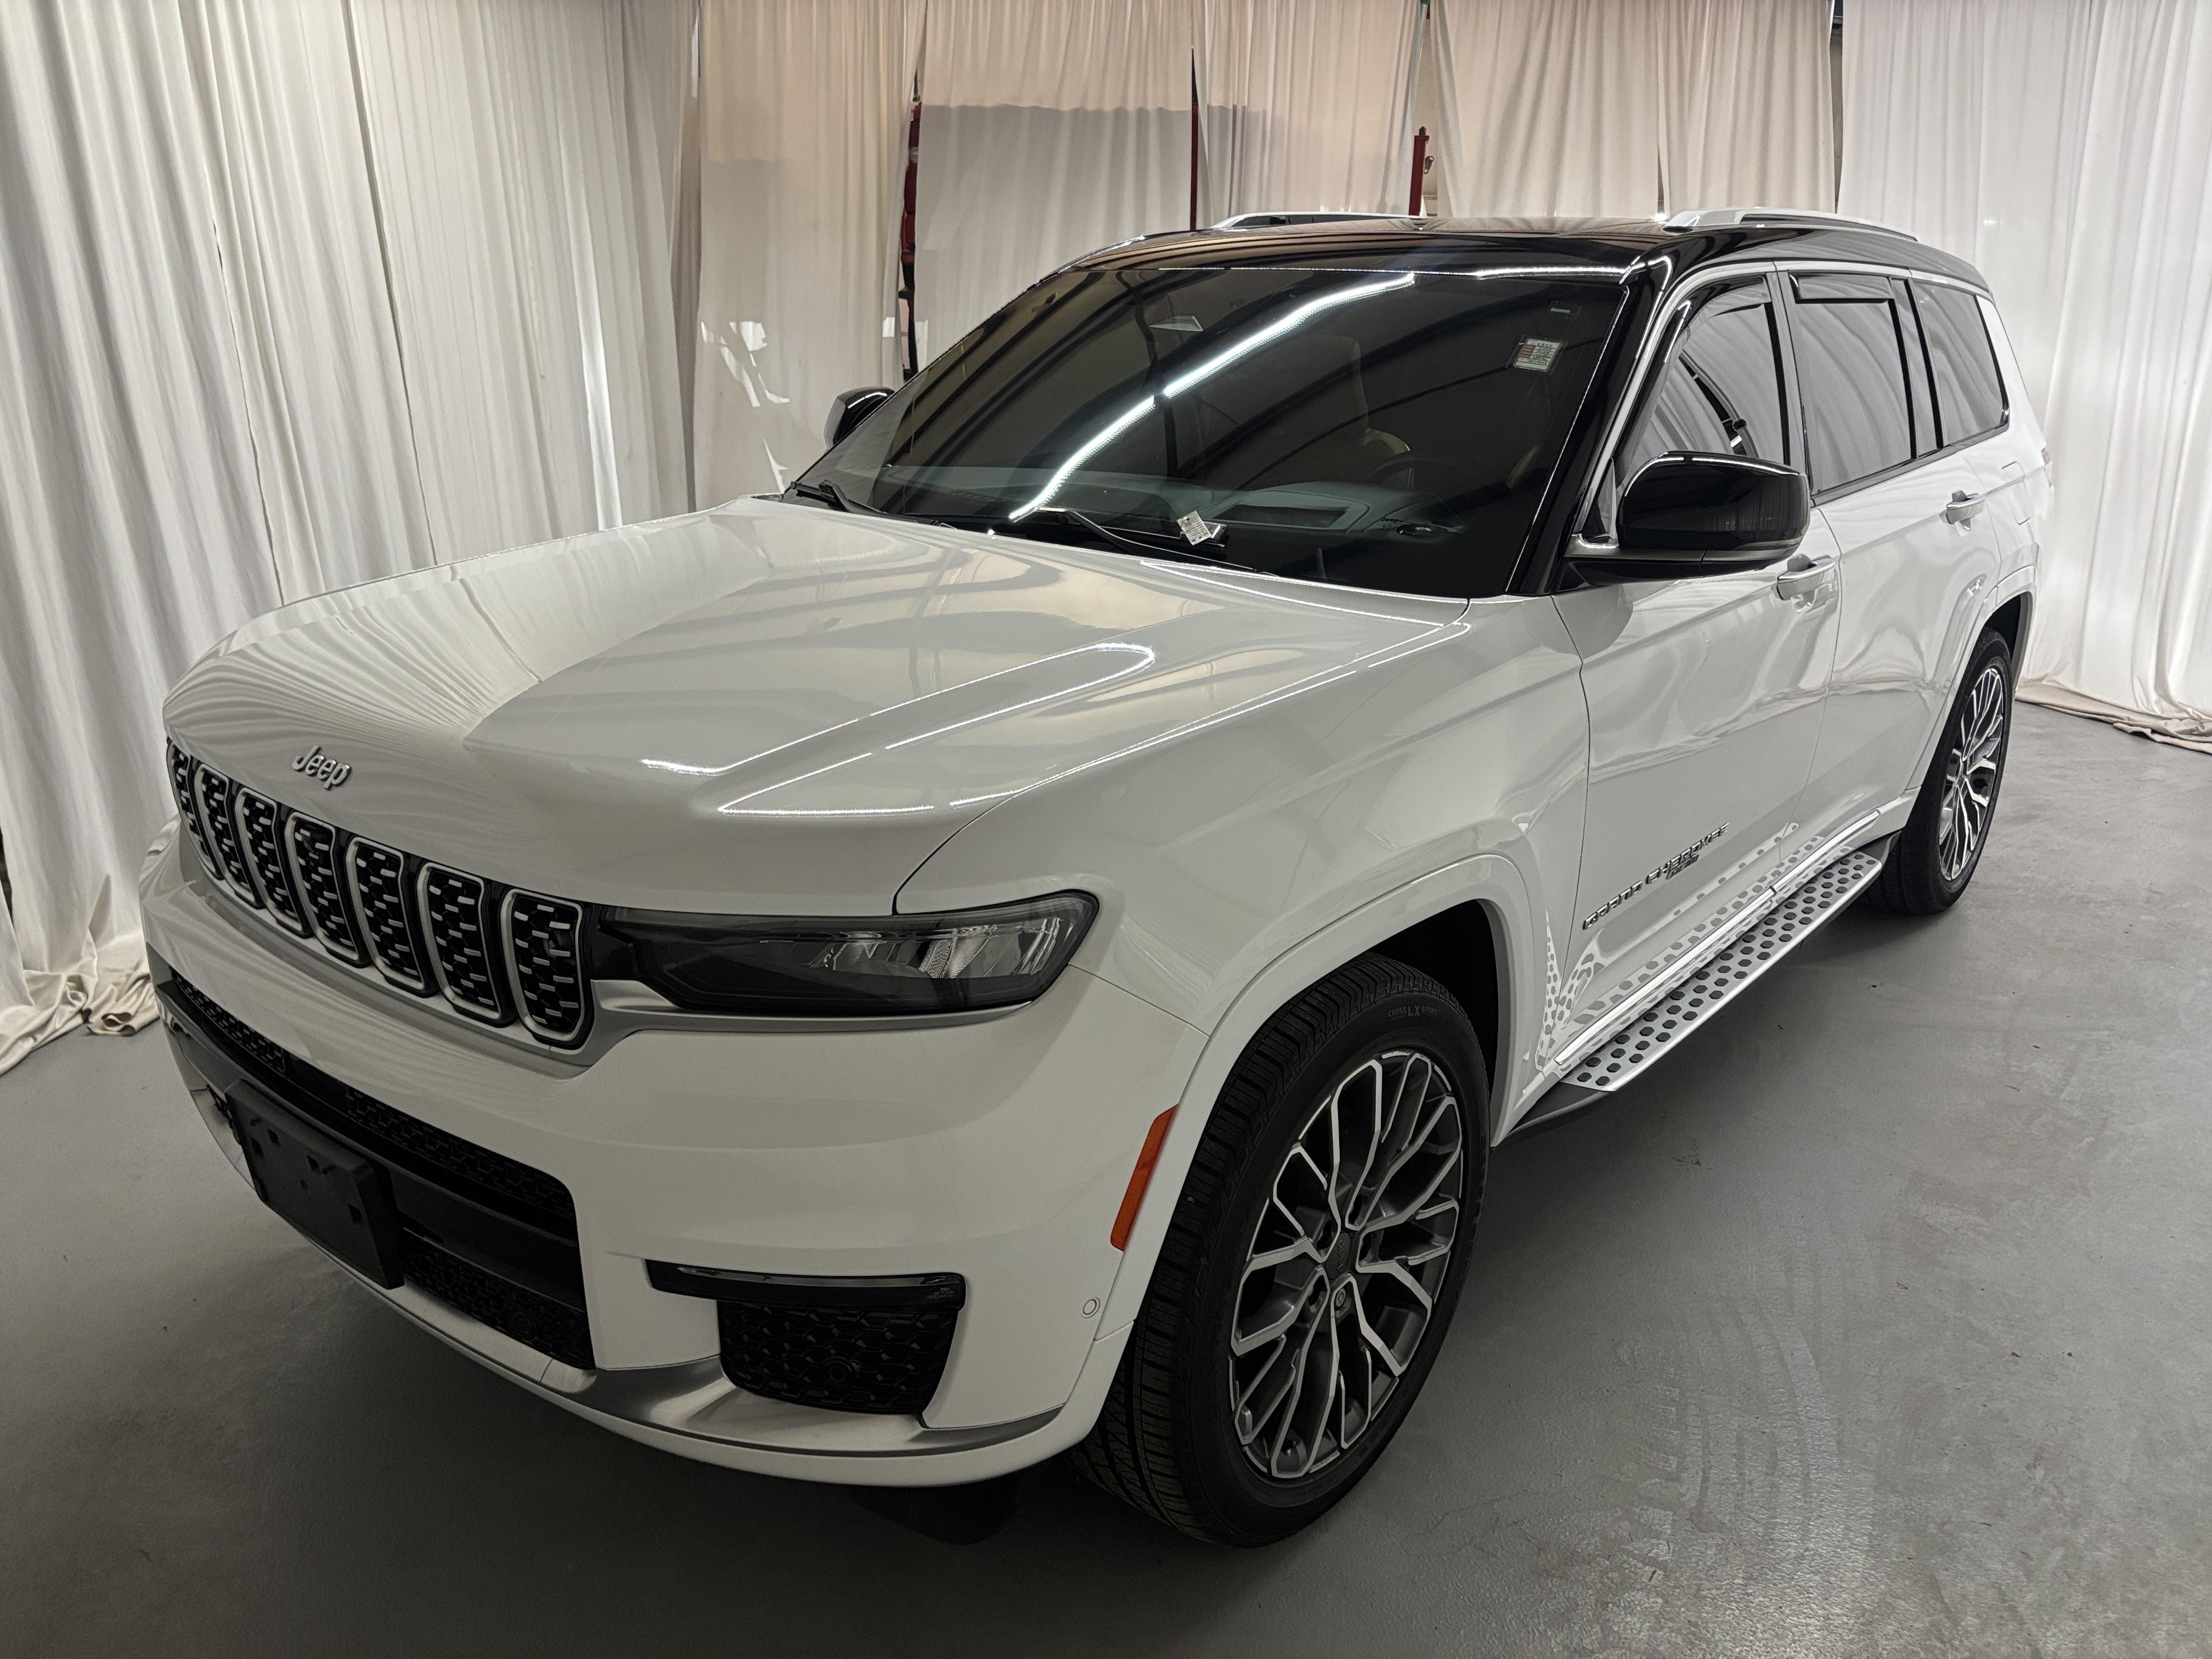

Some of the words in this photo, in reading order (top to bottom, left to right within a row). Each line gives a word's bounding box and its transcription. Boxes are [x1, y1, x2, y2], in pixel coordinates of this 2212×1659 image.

[292, 745, 352, 790] Jeep
[1583, 880, 1643, 930] GRAND
[1645, 822, 1729, 884] CHEROKEE
[1387, 1007, 1407, 1017] CROSS
[1408, 1005, 1420, 1017] LX
